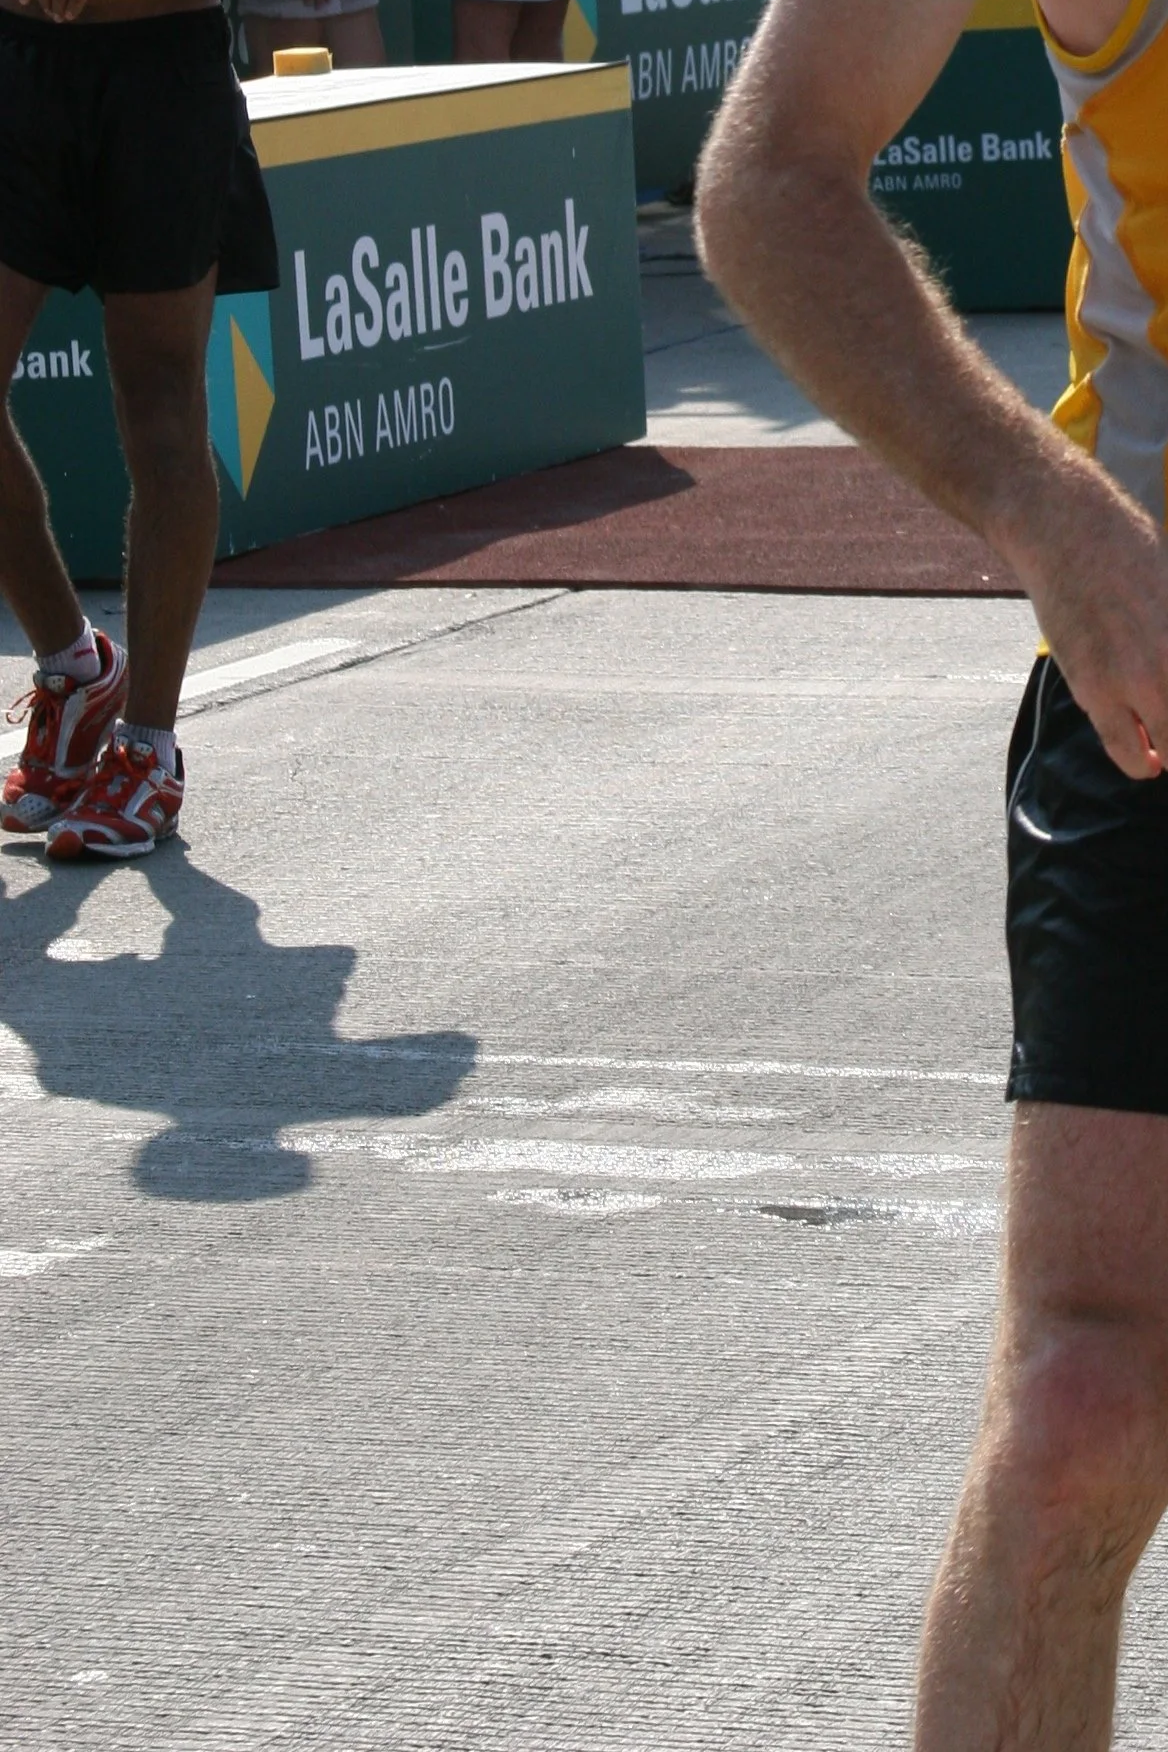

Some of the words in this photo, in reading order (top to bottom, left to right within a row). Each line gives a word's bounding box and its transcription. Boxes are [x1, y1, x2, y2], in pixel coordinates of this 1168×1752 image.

[872, 135, 974, 167] LaSalle
[981, 131, 1053, 162] Bank
[872, 174, 908, 193] ABN
[913, 171, 963, 191] AMRO
[294, 224, 469, 361] LaSalle
[480, 198, 594, 320] Bank
[305, 398, 365, 471] ABN
[375, 376, 456, 452] AMRO
